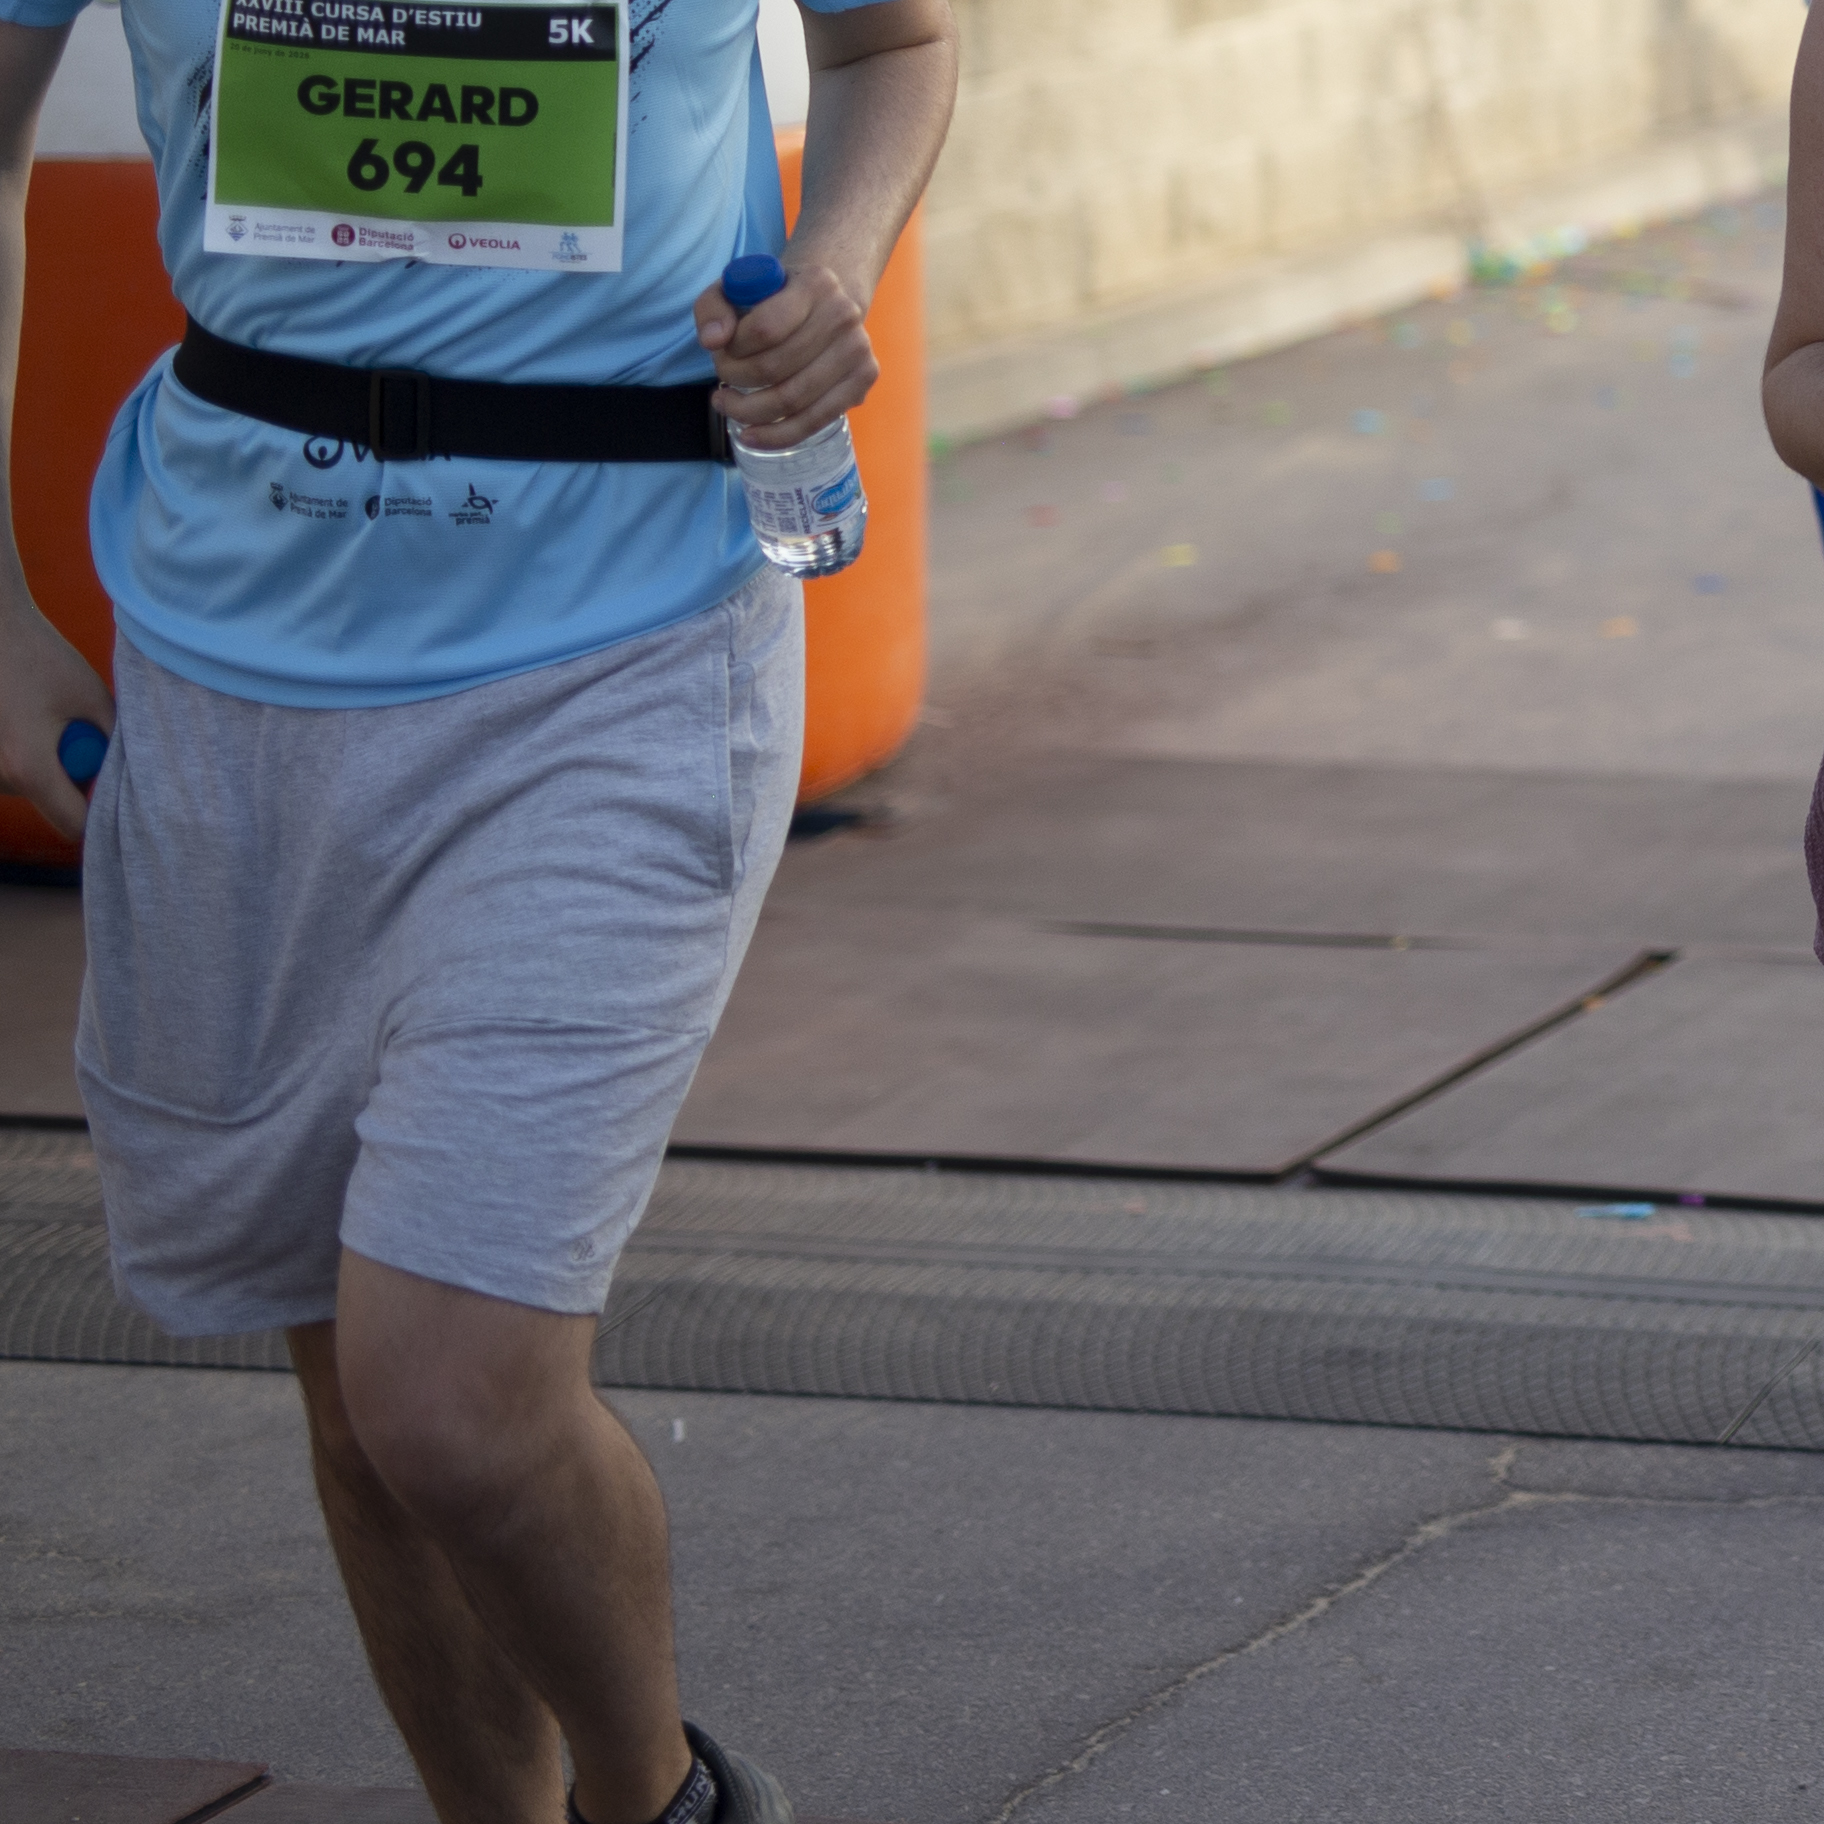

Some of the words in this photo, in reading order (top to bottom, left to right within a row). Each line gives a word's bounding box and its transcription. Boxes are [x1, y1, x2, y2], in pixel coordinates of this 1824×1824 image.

[310, 2, 385, 23] CURSA
[233, 13, 314, 38] PREMIÀ
[321, 24, 350, 41] DE
[356, 28, 406, 46] MAR
[548, 18, 594, 44] 5K
[297, 74, 539, 127] GERARD
[346, 138, 484, 197] 694
[359, 227, 414, 242] Diputació
[359, 237, 414, 251] Barcelona
[469, 238, 521, 251] VEOLIA
